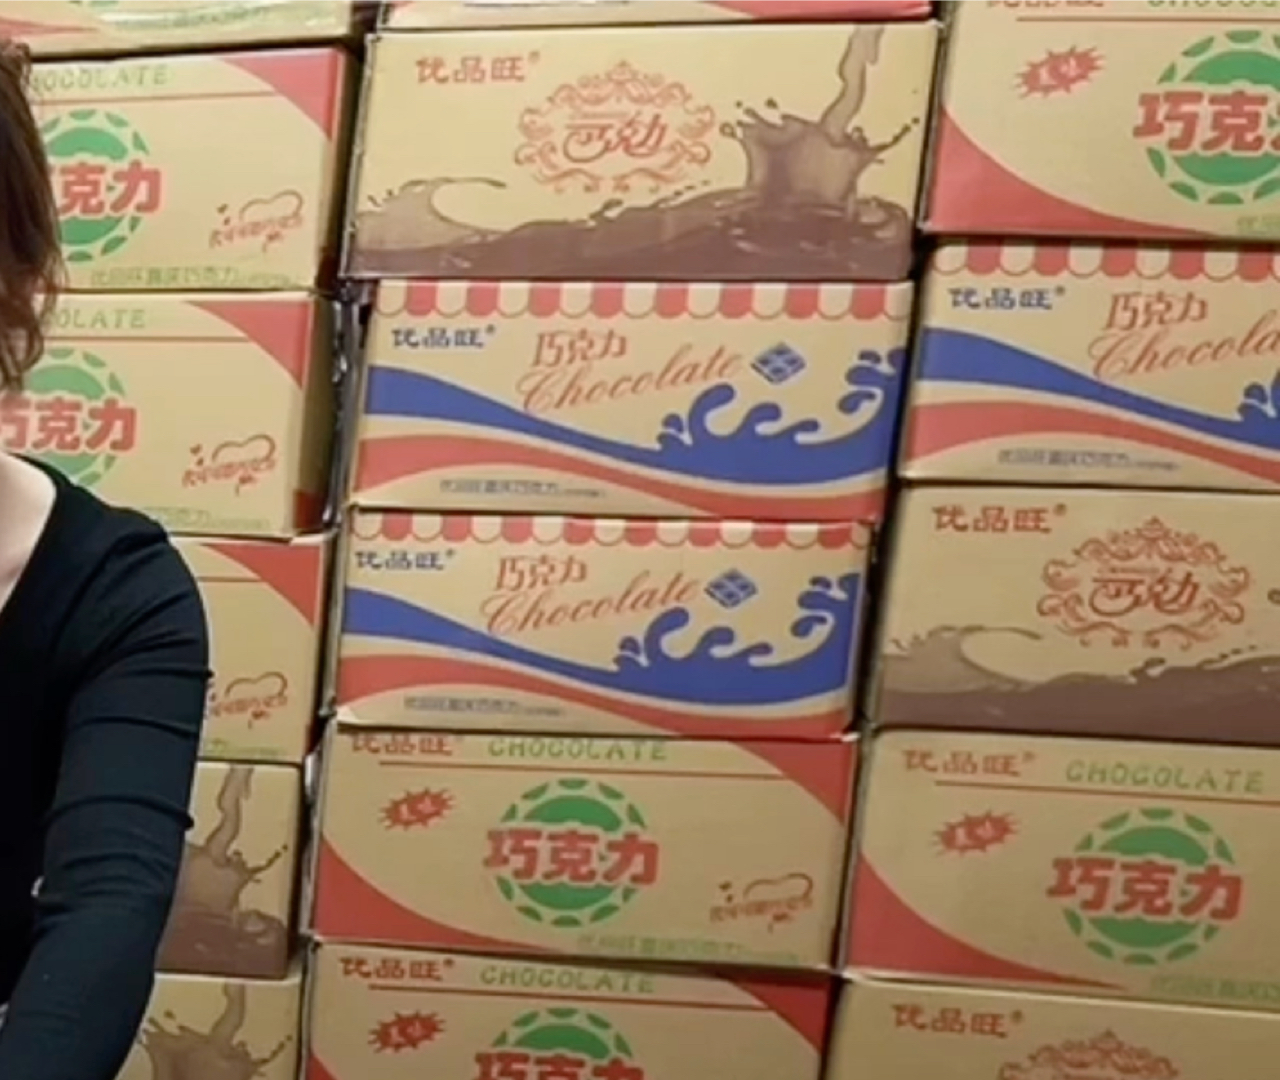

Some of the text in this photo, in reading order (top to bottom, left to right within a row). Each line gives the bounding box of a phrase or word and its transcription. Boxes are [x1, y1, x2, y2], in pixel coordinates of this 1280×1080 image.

[415, 55, 525, 84] 优品旺
[1133, 90, 1280, 152] 巧克
[52, 161, 162, 215] 克力
[1105, 291, 1208, 331] 巧克力
[537, 329, 627, 367] 巧克力
[1087, 308, 1280, 379] Chocola
[517, 343, 743, 411] Chocolate
[933, 505, 1053, 534] 优品旺
[495, 553, 588, 592] 巧克力
[480, 567, 698, 638] Chocolate
[488, 737, 667, 763] CHOCOLATE
[1067, 759, 1264, 794] CHOCOLATE
[483, 827, 660, 888] 巧克力
[1045, 856, 1245, 921] 巧克力
[480, 964, 655, 994] CHOCOLATE
